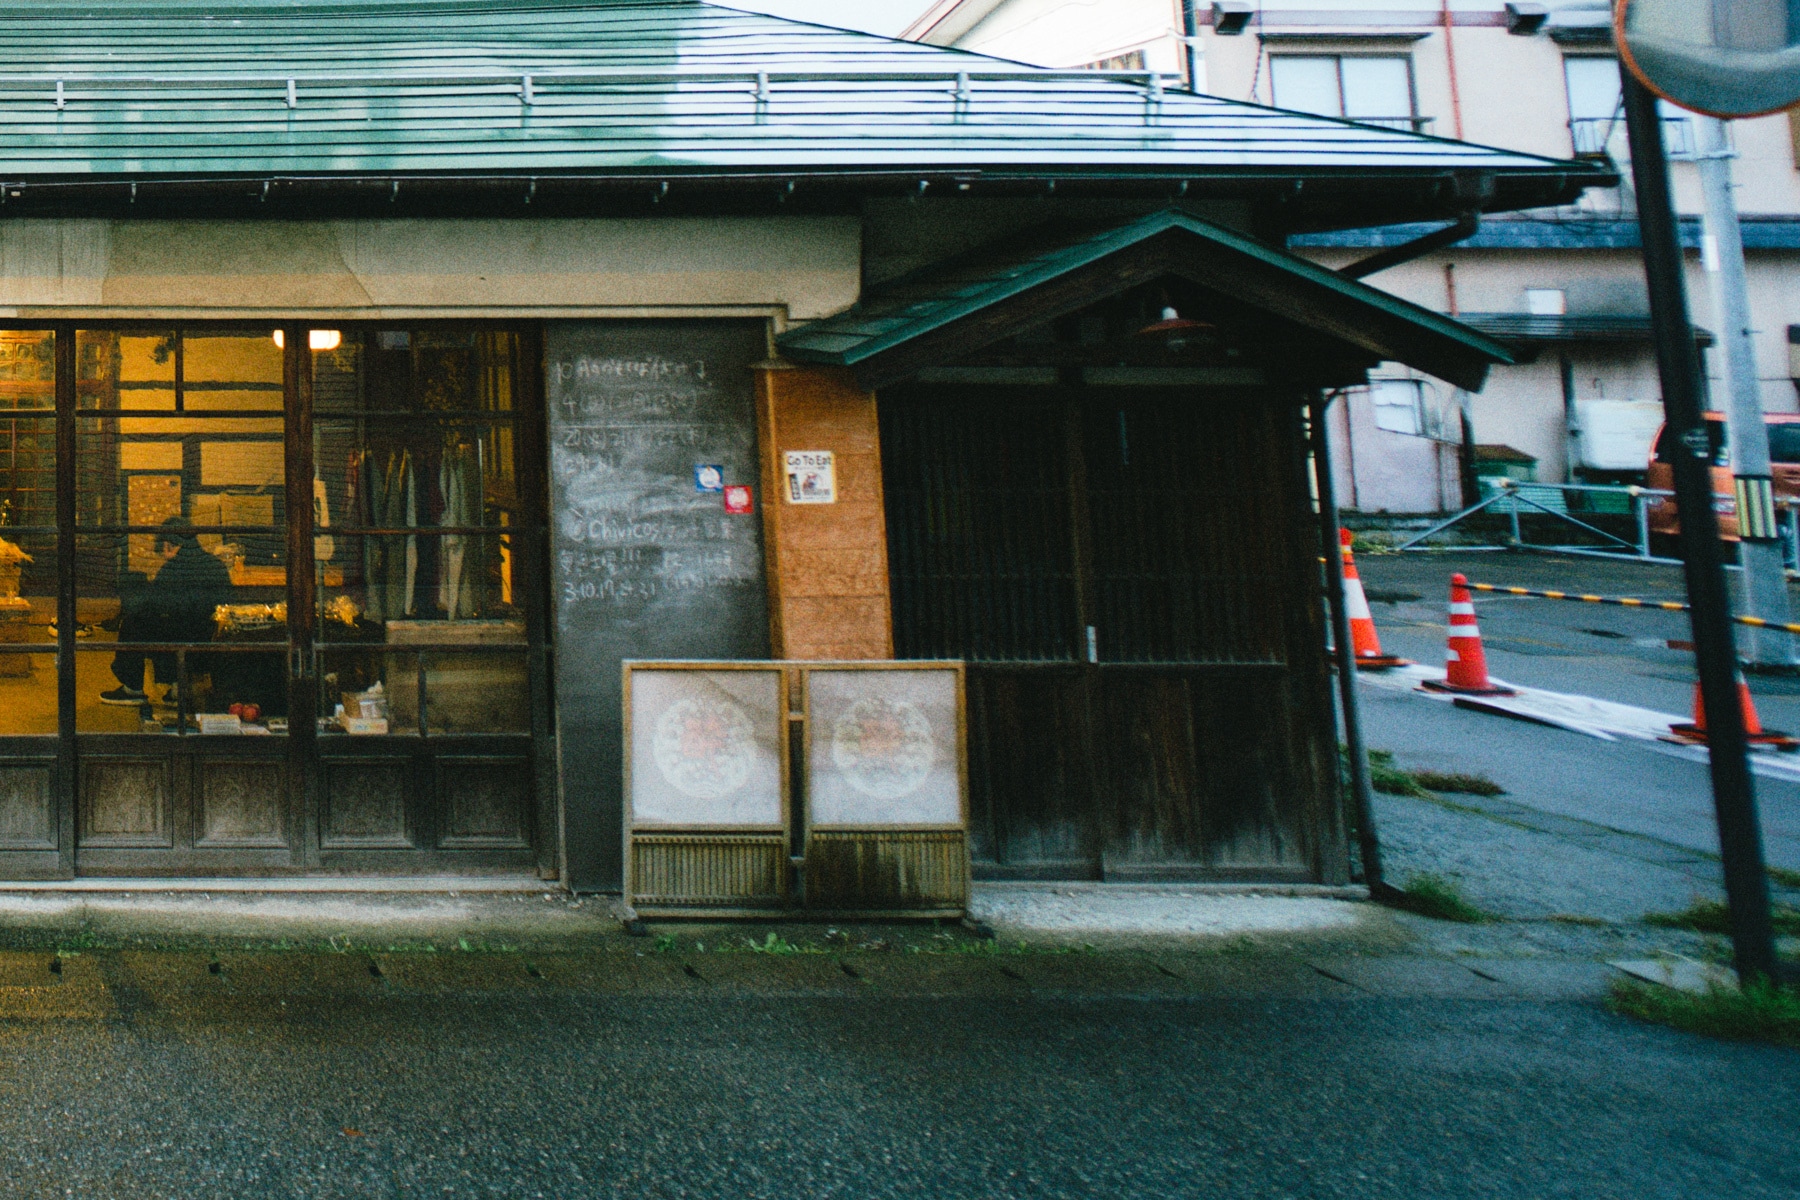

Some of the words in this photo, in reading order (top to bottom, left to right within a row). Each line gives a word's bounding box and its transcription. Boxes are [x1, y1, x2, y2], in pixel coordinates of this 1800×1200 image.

[787, 454, 802, 466] Go
[802, 454, 815, 466] To
[816, 454, 832, 466] Eat
